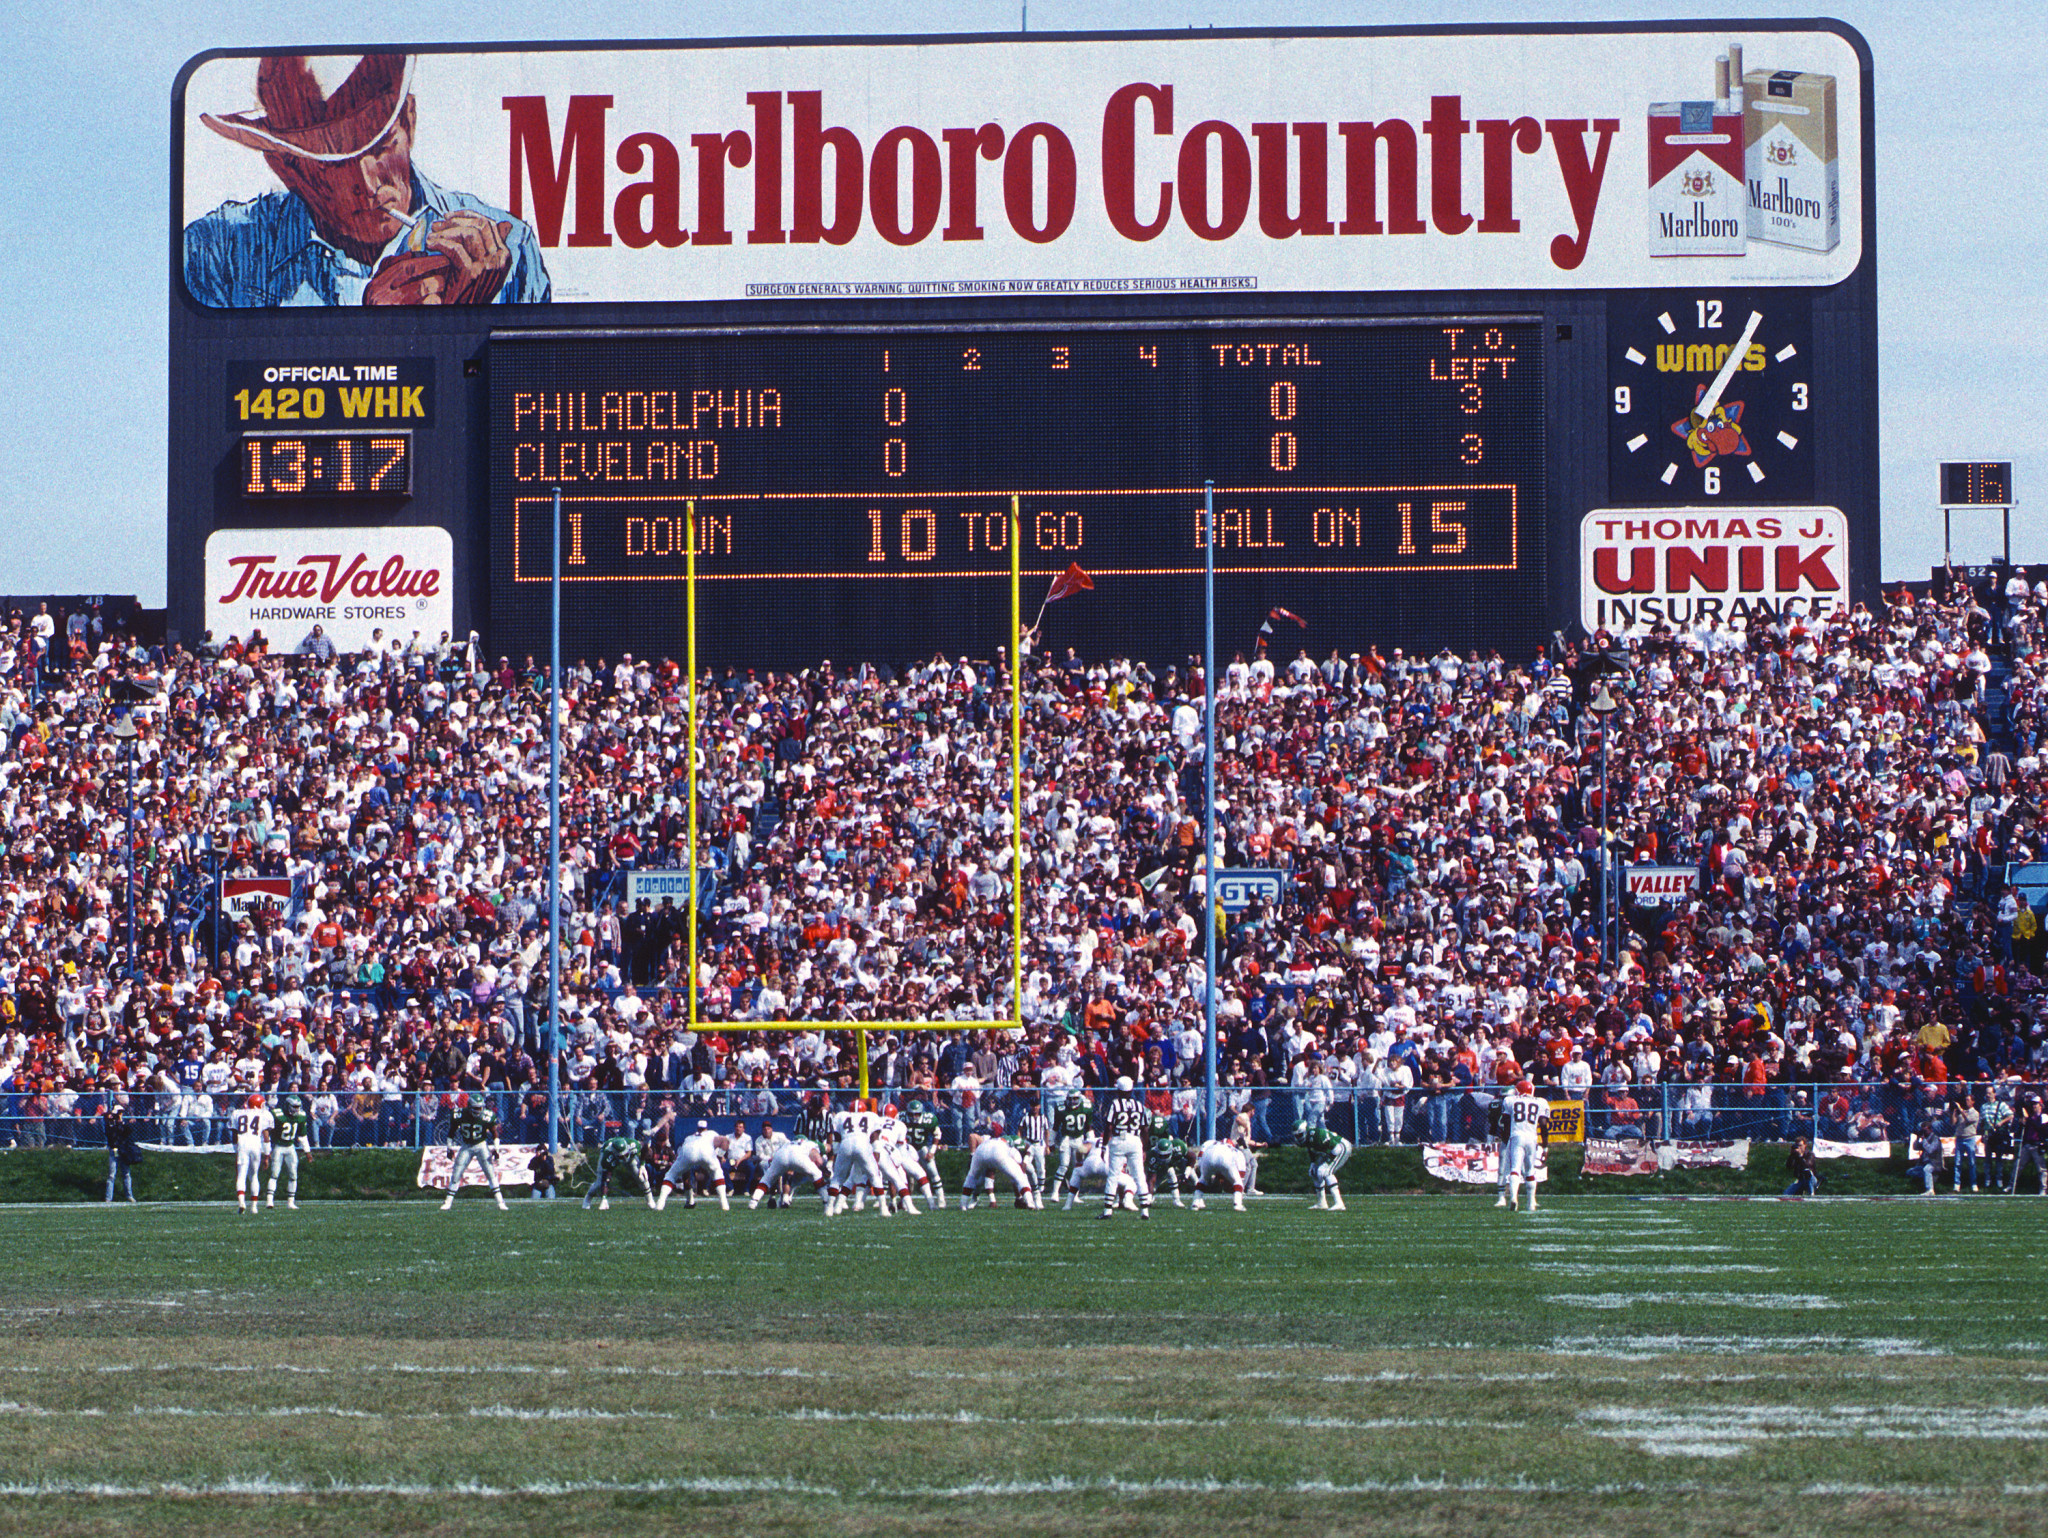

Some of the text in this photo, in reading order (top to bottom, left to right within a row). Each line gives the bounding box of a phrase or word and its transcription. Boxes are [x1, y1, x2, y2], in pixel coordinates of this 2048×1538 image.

[502, 82, 1620, 270] Marlboro Country
[1748, 177, 1821, 220] Marlboro
[1659, 201, 1739, 238] Marlboro
[1771, 216, 1797, 229] 100's
[750, 284, 796, 295] SURGEON
[799, 283, 852, 295] GENERAL'S
[908, 282, 955, 293] QUITTING
[958, 281, 1006, 292] SMOKING
[1008, 280, 1033, 291] NOW
[1036, 280, 1080, 291] GREATLY
[1083, 279, 1129, 290] REDUCES
[1132, 279, 1177, 289] SERIOUS
[1179, 278, 1218, 289] HEALTH
[1221, 277, 1254, 288] RISKS.
[1696, 300, 1723, 328] 12
[883, 343, 1322, 372] 1 2 3 4 TOTAL
[1430, 357, 1516, 380] LEFT
[264, 365, 398, 383] OFFICIAL TIME
[234, 385, 425, 420] 1420 WHK
[515, 381, 1483, 431] PHILADELPHIA 0 0 3
[1614, 386, 1631, 414] 9
[1791, 382, 1808, 411] 3
[247, 439, 405, 492] 13:17
[515, 432, 1483, 482] CLEVELAND 0 0 3
[1704, 466, 1721, 495] 6
[1968, 464, 2003, 503] 16
[568, 501, 1467, 565] 1 DOWN 10 TO GO BALL ON 15
[1596, 518, 1833, 541] THOMAS J.
[1593, 545, 1841, 595] UNIK
[1968, 567, 1986, 578] 52
[250, 606, 406, 620] HARDWARE STORES
[1597, 597, 1833, 626] INSURANCE
[636, 877, 690, 894] digital
[1220, 882, 1274, 900] GTE
[1630, 875, 1696, 893] VALLEY
[1447, 993, 1462, 1006] 61
[184, 1065, 199, 1079] 15
[238, 1115, 260, 1135] 84
[843, 1116, 868, 1133] 44
[1065, 1113, 1087, 1131] 20
[1117, 1111, 1141, 1131] 23
[1513, 1102, 1539, 1125] 88
[1550, 1107, 1581, 1120] CBS
[281, 1122, 298, 1140] 21
[461, 1123, 483, 1139] 52
